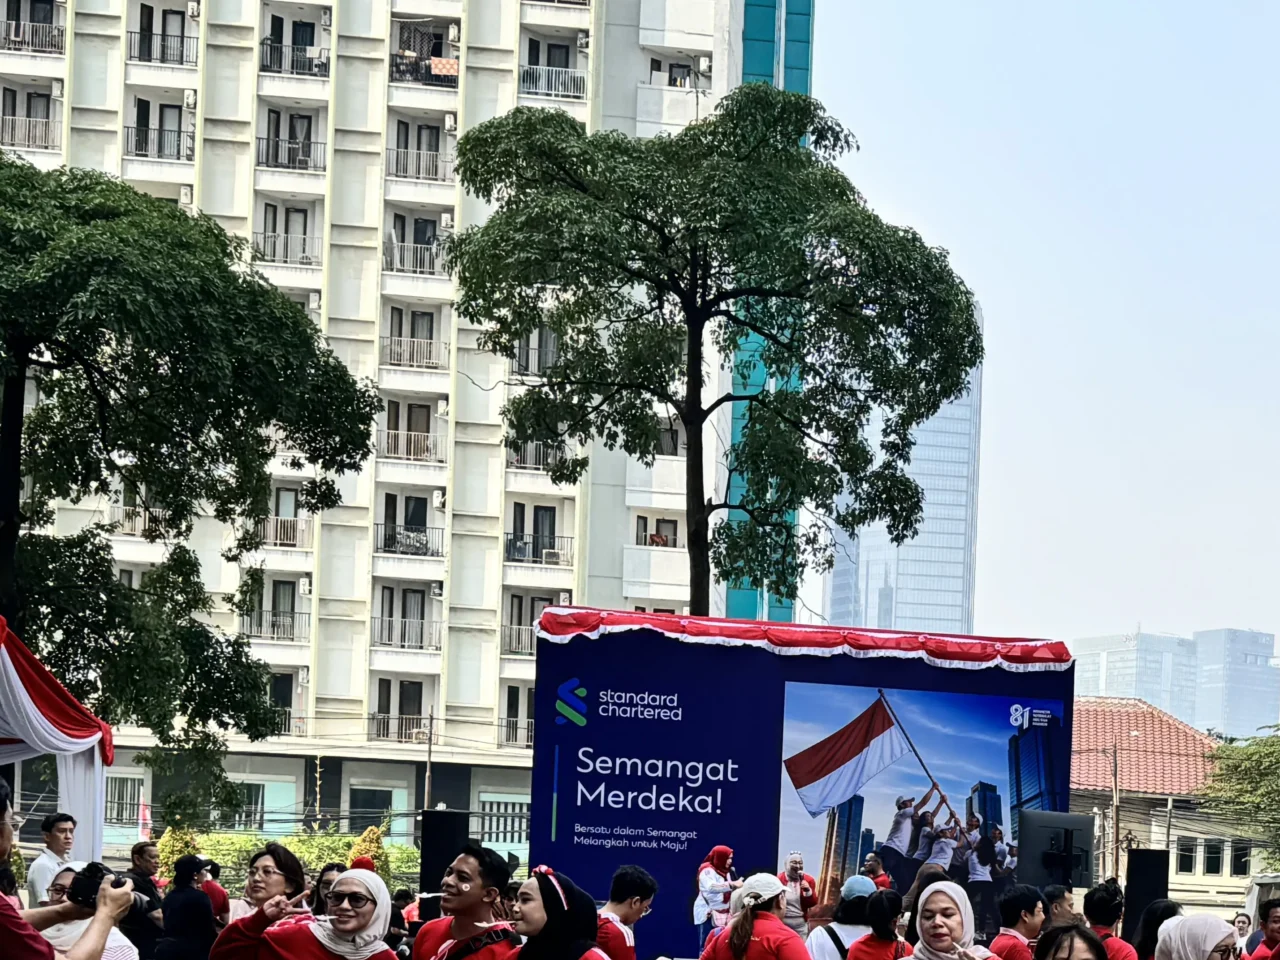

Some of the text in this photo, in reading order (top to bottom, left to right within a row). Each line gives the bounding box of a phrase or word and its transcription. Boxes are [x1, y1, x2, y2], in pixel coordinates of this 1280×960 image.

[599, 689, 678, 707] standard
[598, 703, 682, 721] chartered
[576, 747, 739, 787] Semangat
[576, 780, 722, 814] Merdeka!
[574, 823, 698, 840] Bersatu dalam Semangat
[573, 835, 688, 852] Melangkah untuk Maju!
